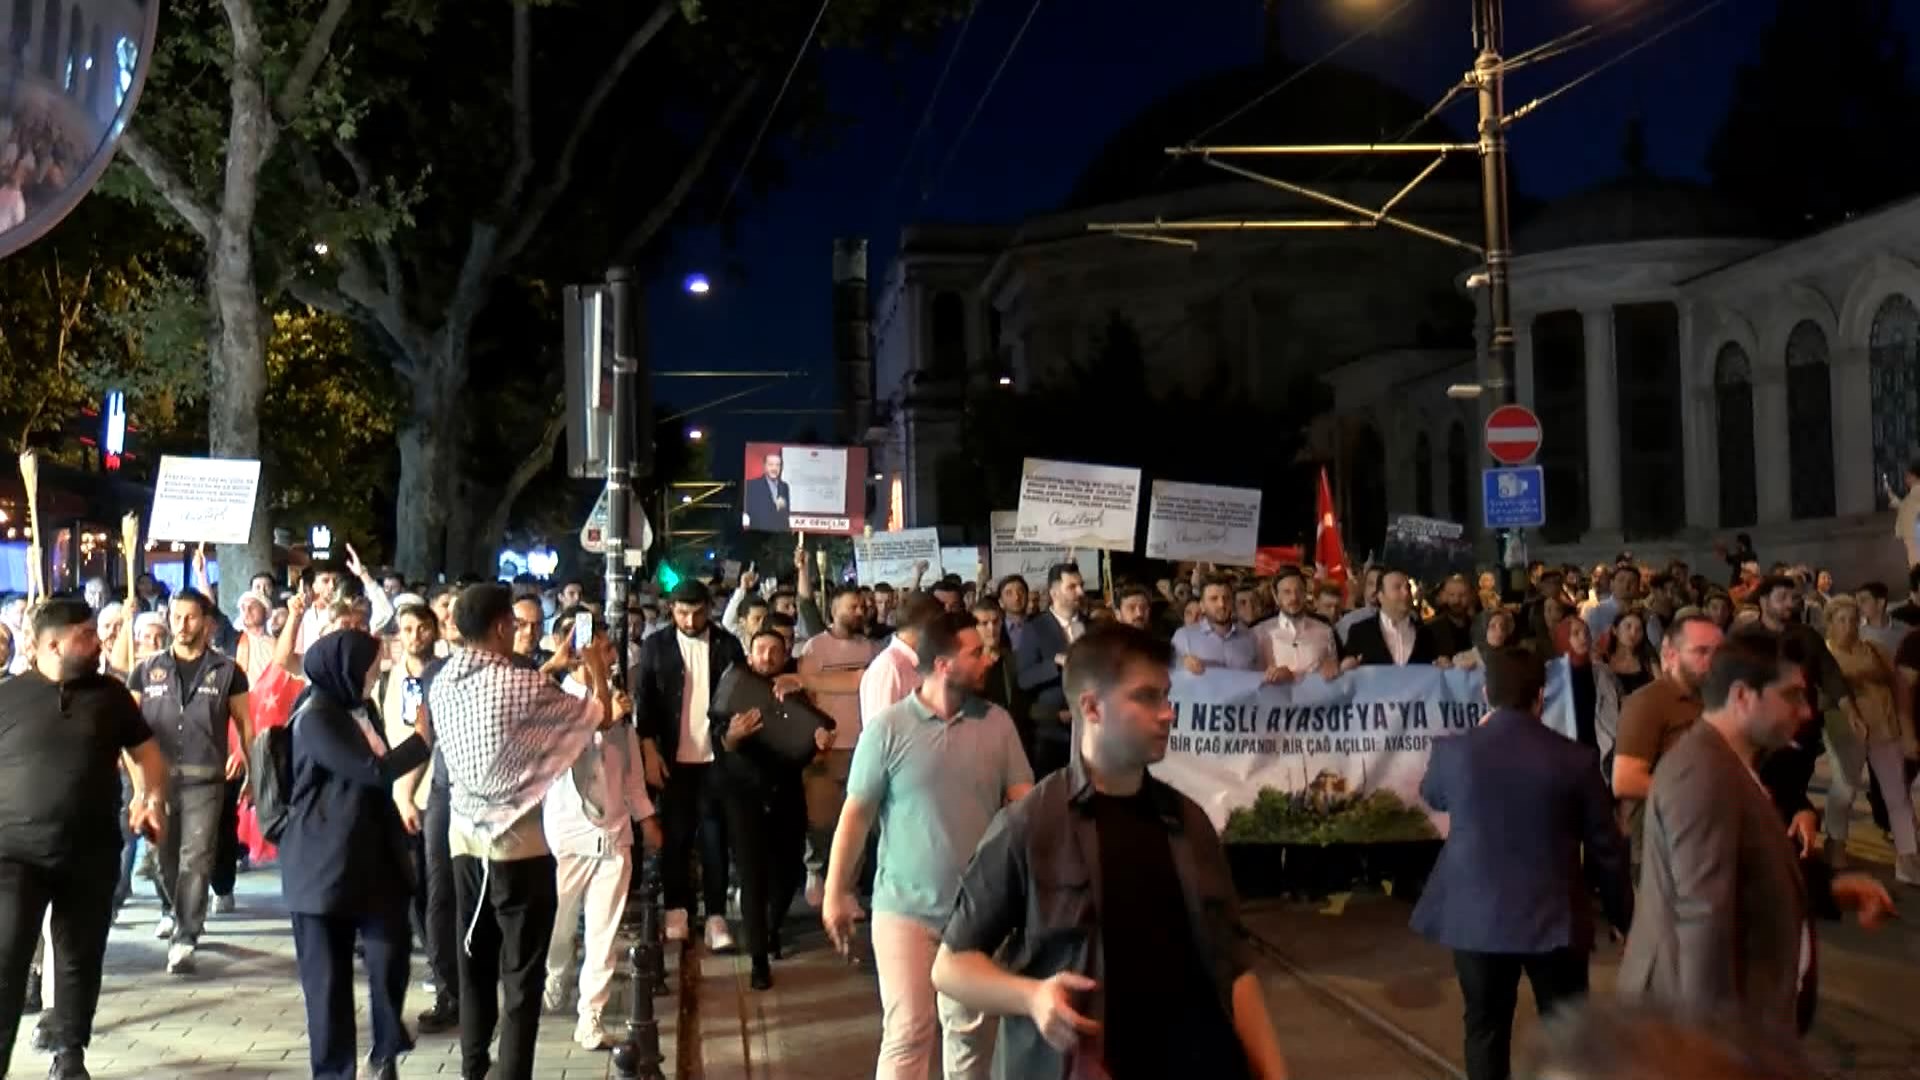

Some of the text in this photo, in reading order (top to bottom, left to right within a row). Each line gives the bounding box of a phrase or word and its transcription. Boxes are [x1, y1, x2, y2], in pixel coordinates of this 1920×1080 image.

[1192, 703, 1258, 733] NESLİ
[1266, 701, 1428, 733] AYASOFYA'YA
[1170, 733, 1191, 752] BİR
[1195, 735, 1221, 756] ÇAĞ
[1282, 736, 1303, 754] BİR
[1306, 735, 1331, 757] ÇAĞ
